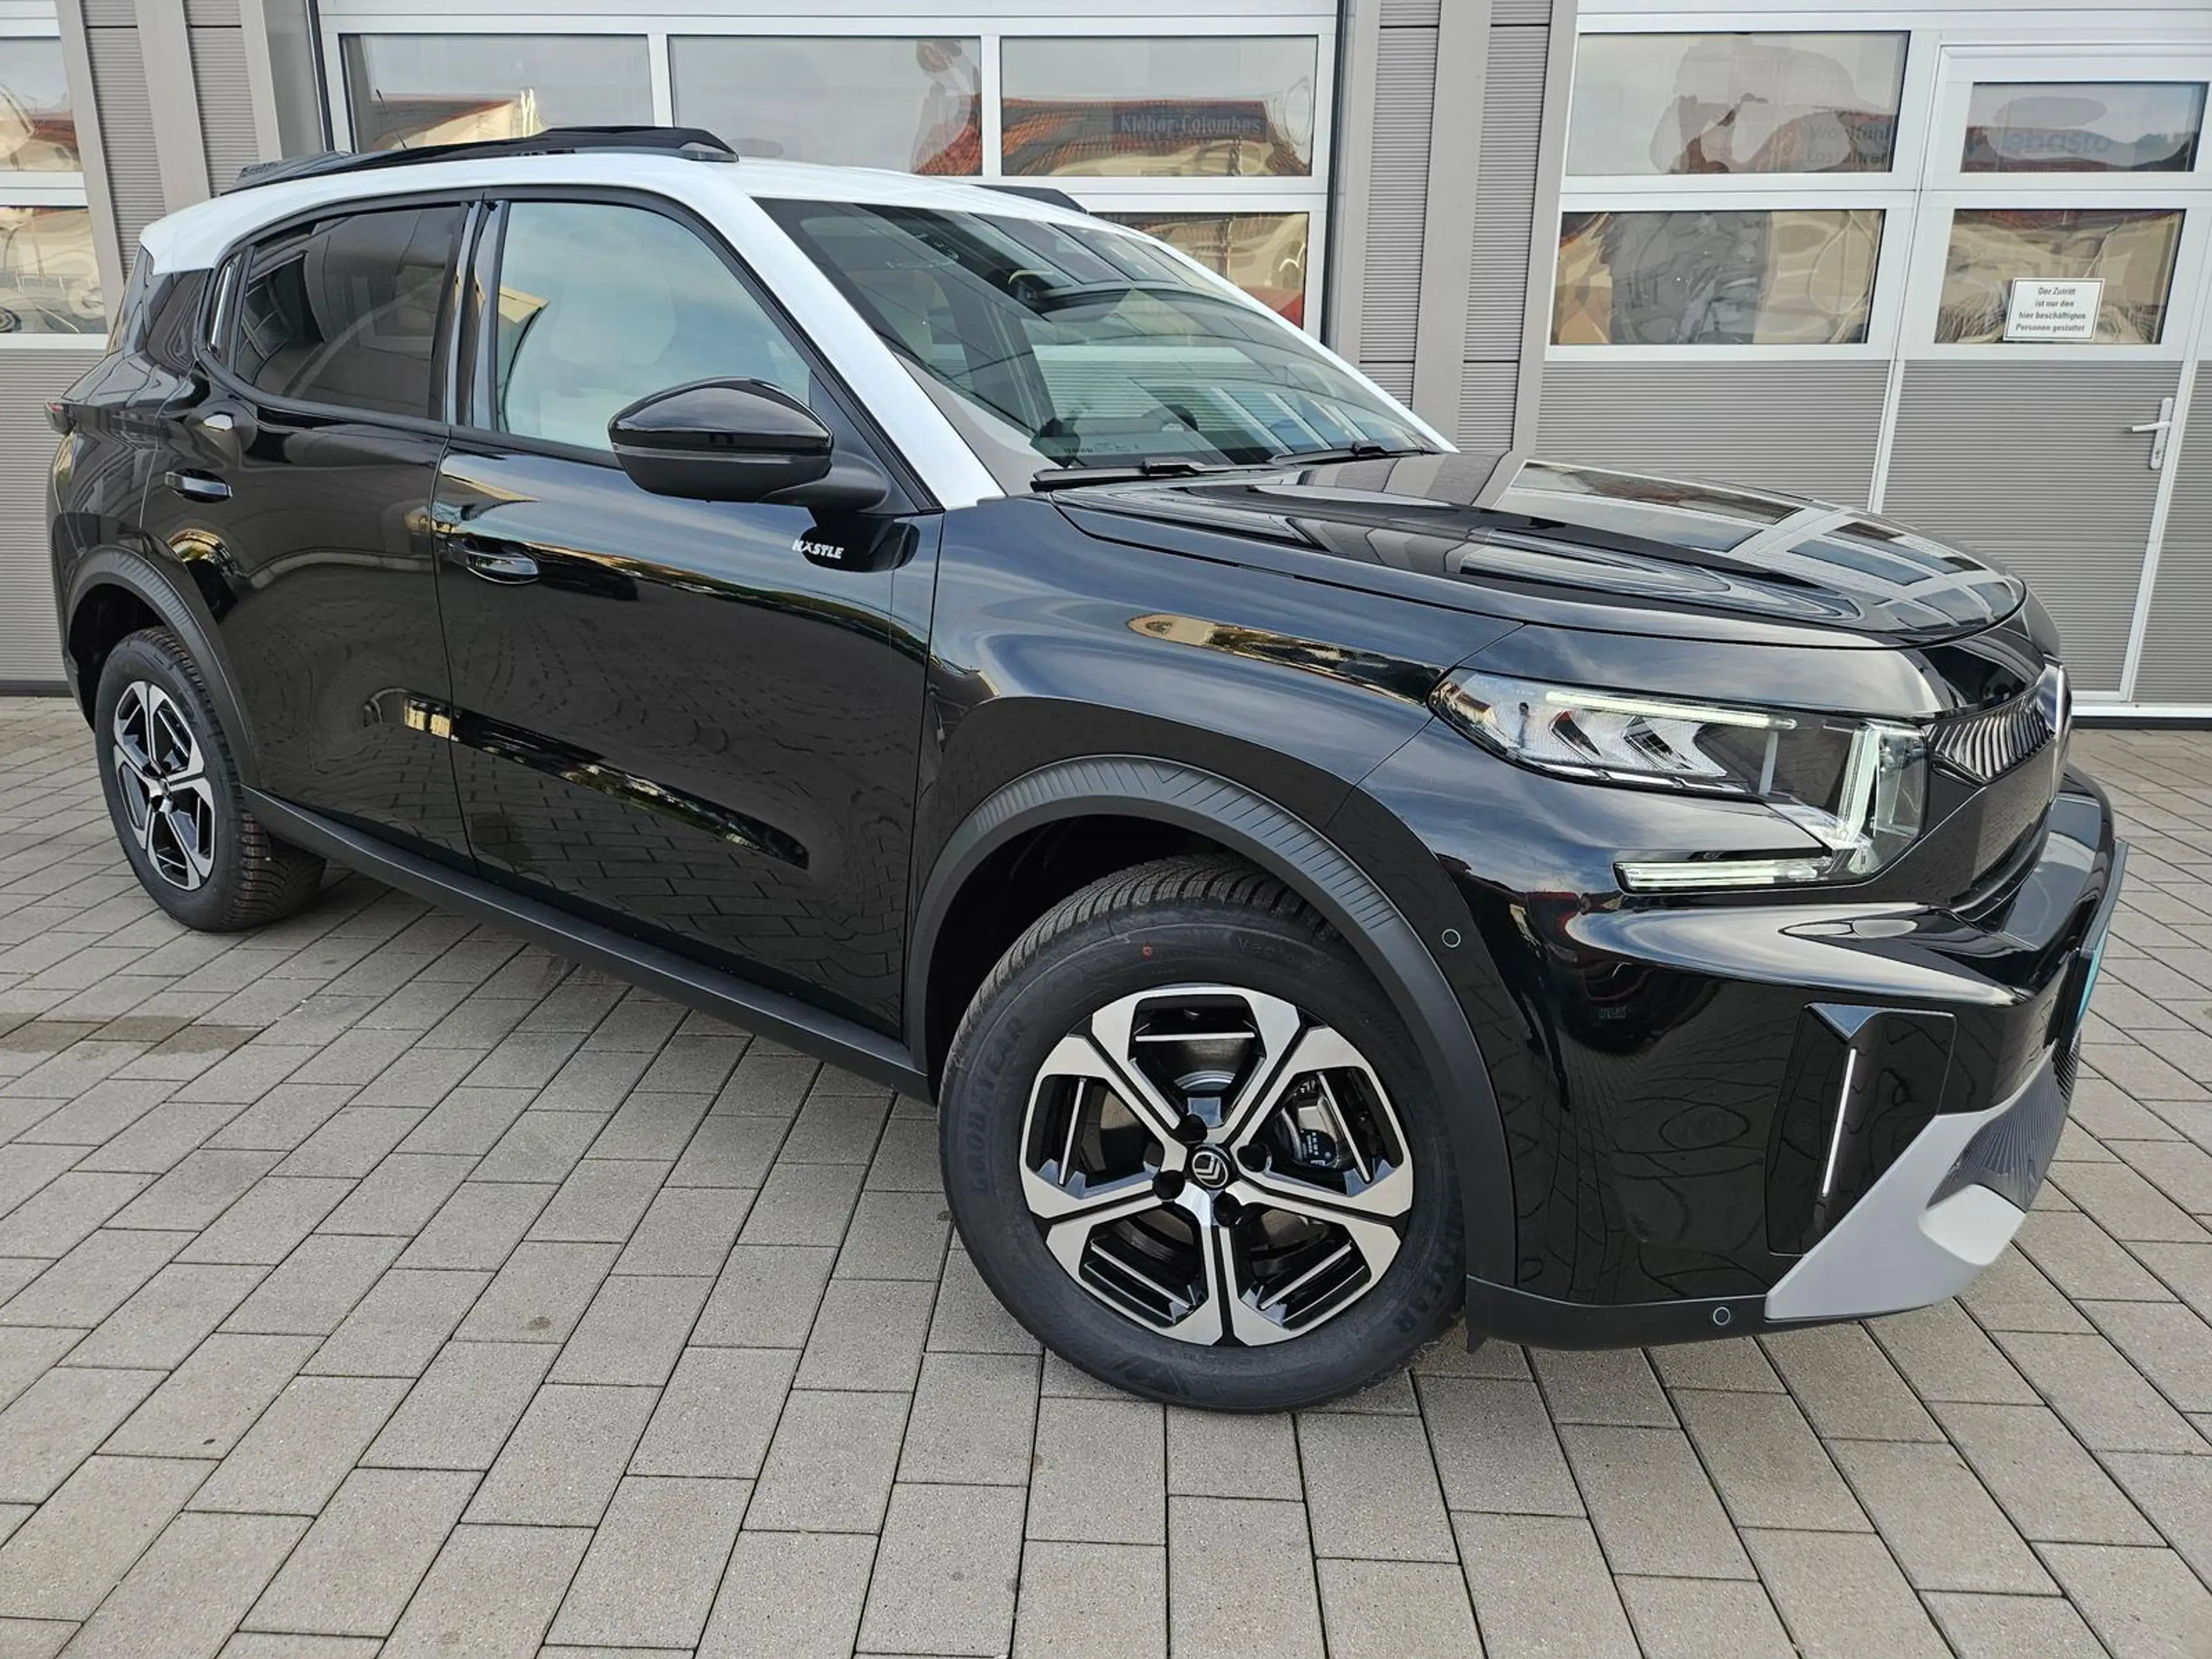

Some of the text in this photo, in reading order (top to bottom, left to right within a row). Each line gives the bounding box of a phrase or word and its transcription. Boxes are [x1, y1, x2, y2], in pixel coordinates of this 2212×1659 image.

[2035, 299, 2045, 307] ist
[2018, 311, 2086, 321] hier beschäftigten
[2015, 323, 2085, 332] Personen gestattet
